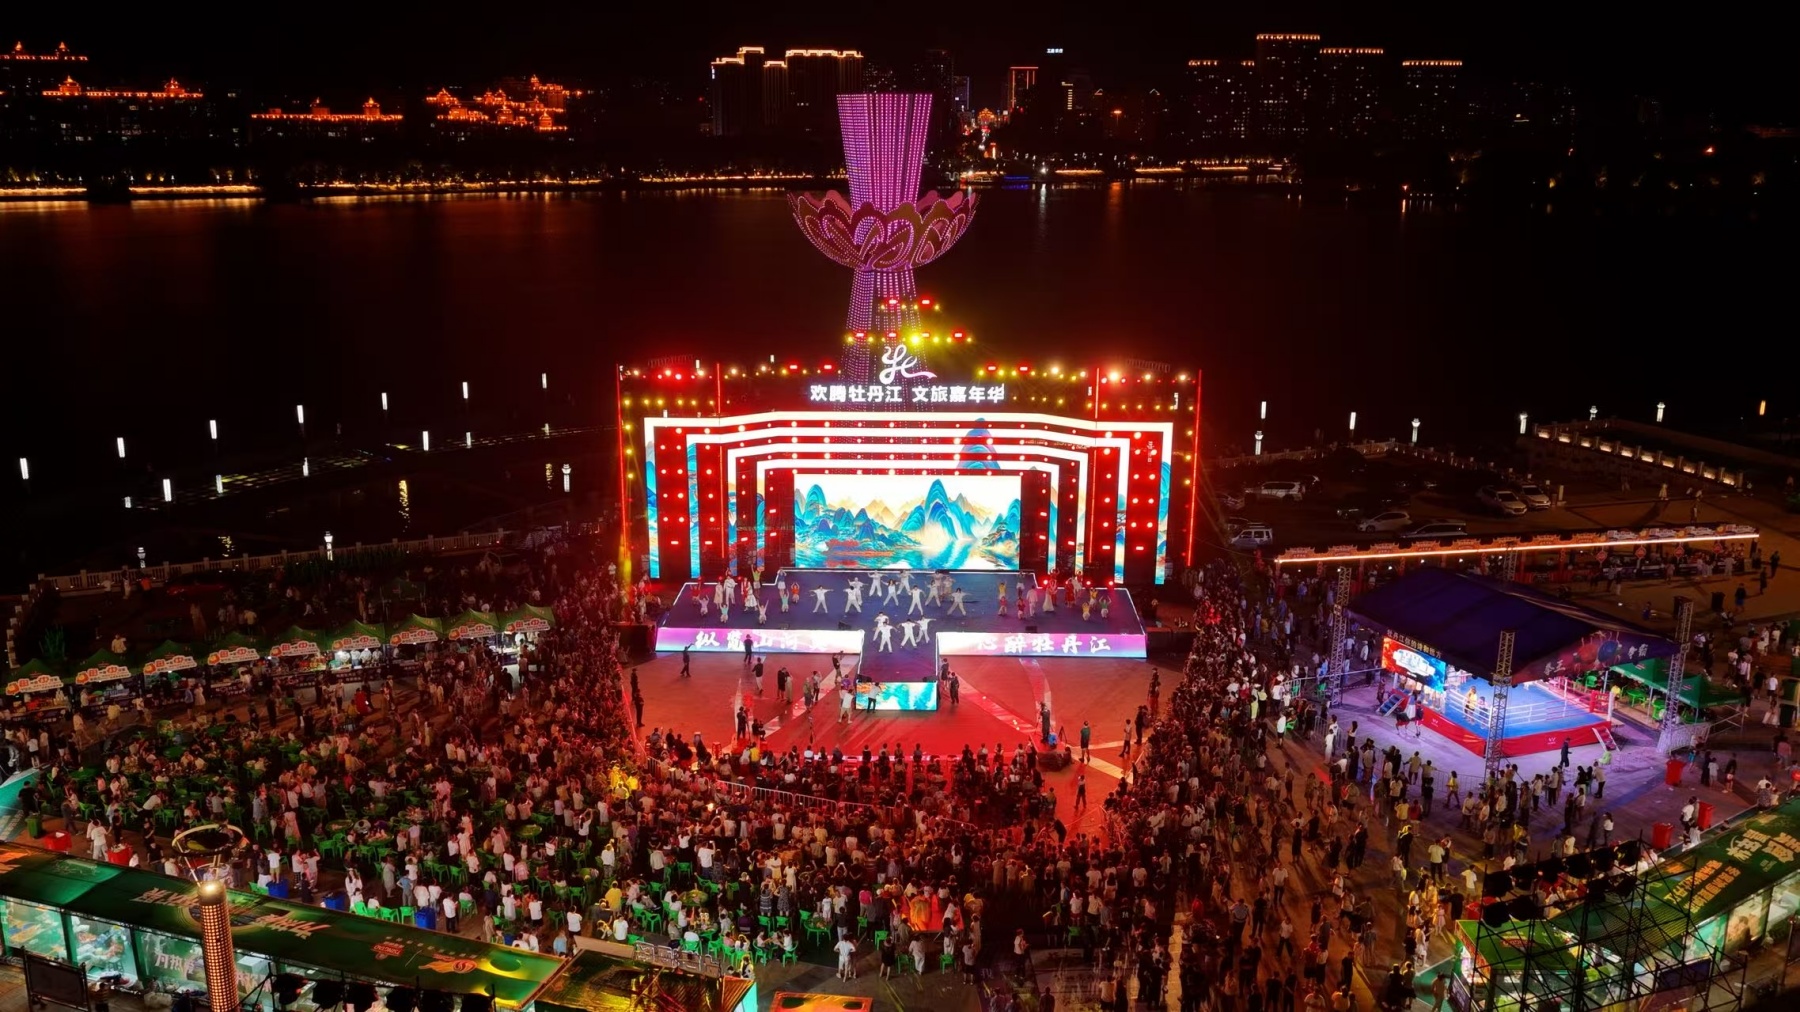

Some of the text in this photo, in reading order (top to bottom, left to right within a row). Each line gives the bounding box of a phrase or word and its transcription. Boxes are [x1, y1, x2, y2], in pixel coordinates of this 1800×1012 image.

[810, 383, 1005, 404] 欢腾牡丹江 文旅嘉年华
[694, 629, 828, 652] 纵览山河
[976, 631, 1112, 655] 心醉牡丹江
[1627, 642, 1649, 660] 争霸
[1543, 659, 1567, 676] 拳王
